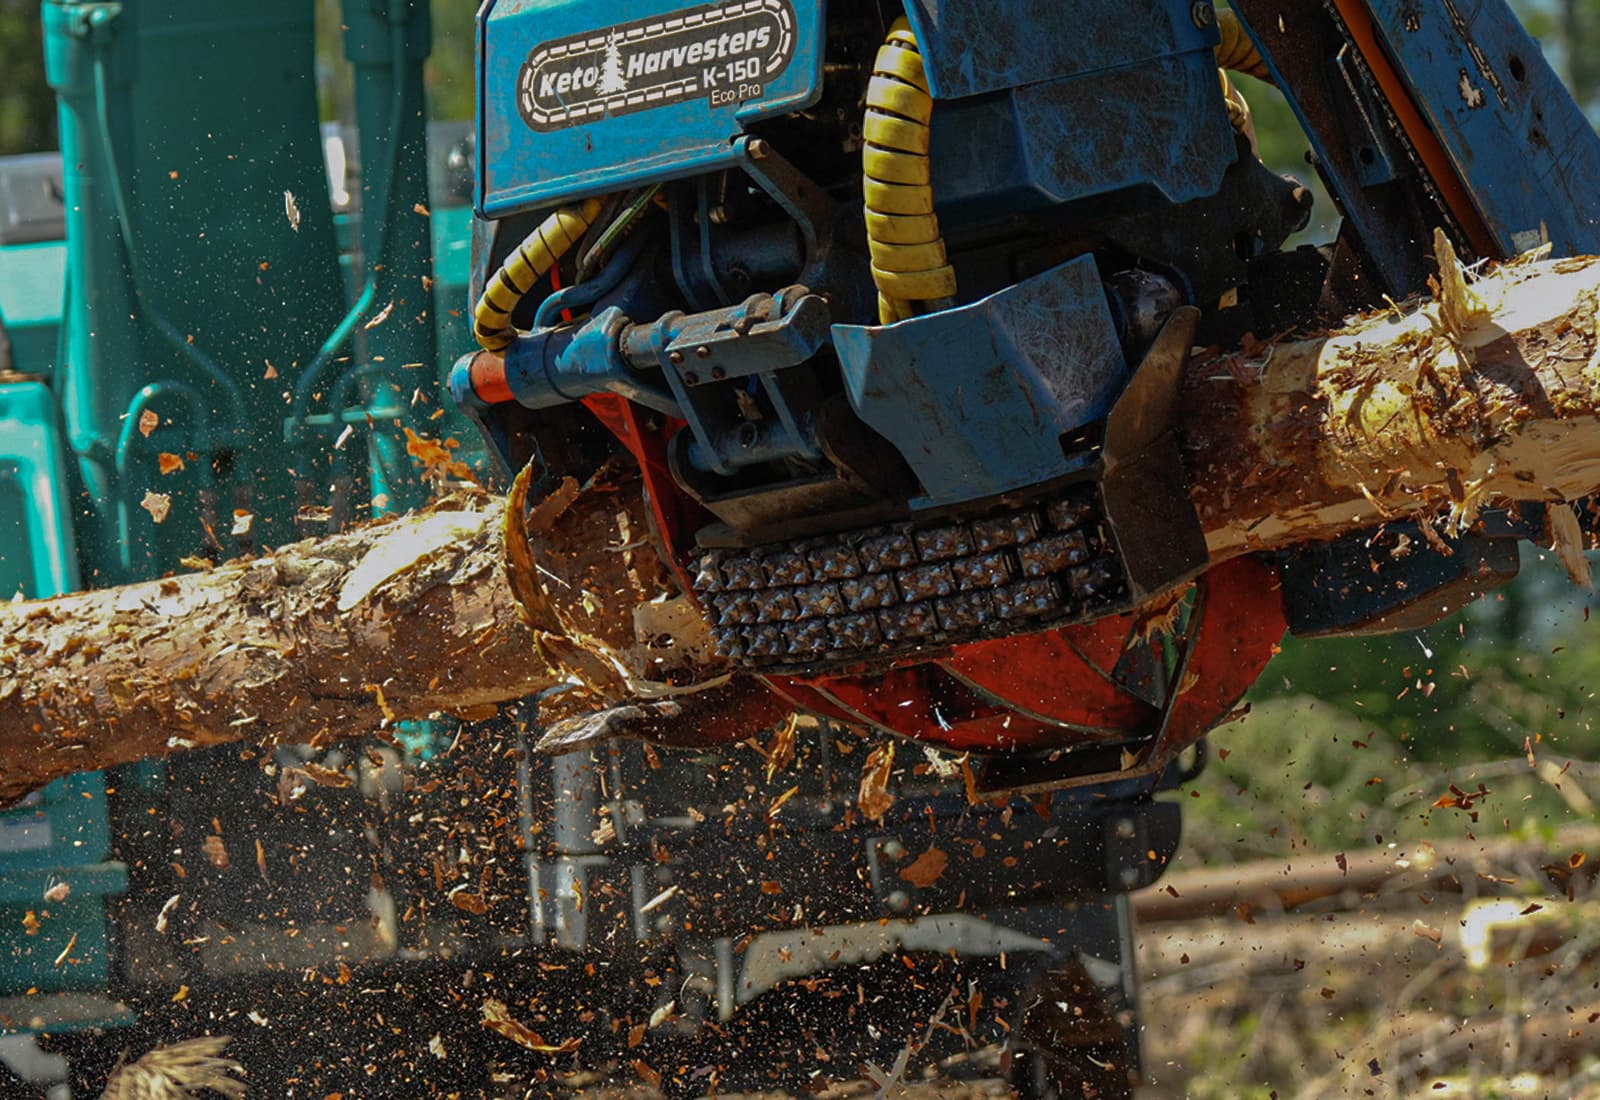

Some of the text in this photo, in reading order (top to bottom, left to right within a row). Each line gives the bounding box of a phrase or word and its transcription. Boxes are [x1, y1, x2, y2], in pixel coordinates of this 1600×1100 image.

[539, 25, 771, 99] Keto Harvesters
[703, 57, 760, 89] K-150
[711, 83, 761, 105] Eco Pro
